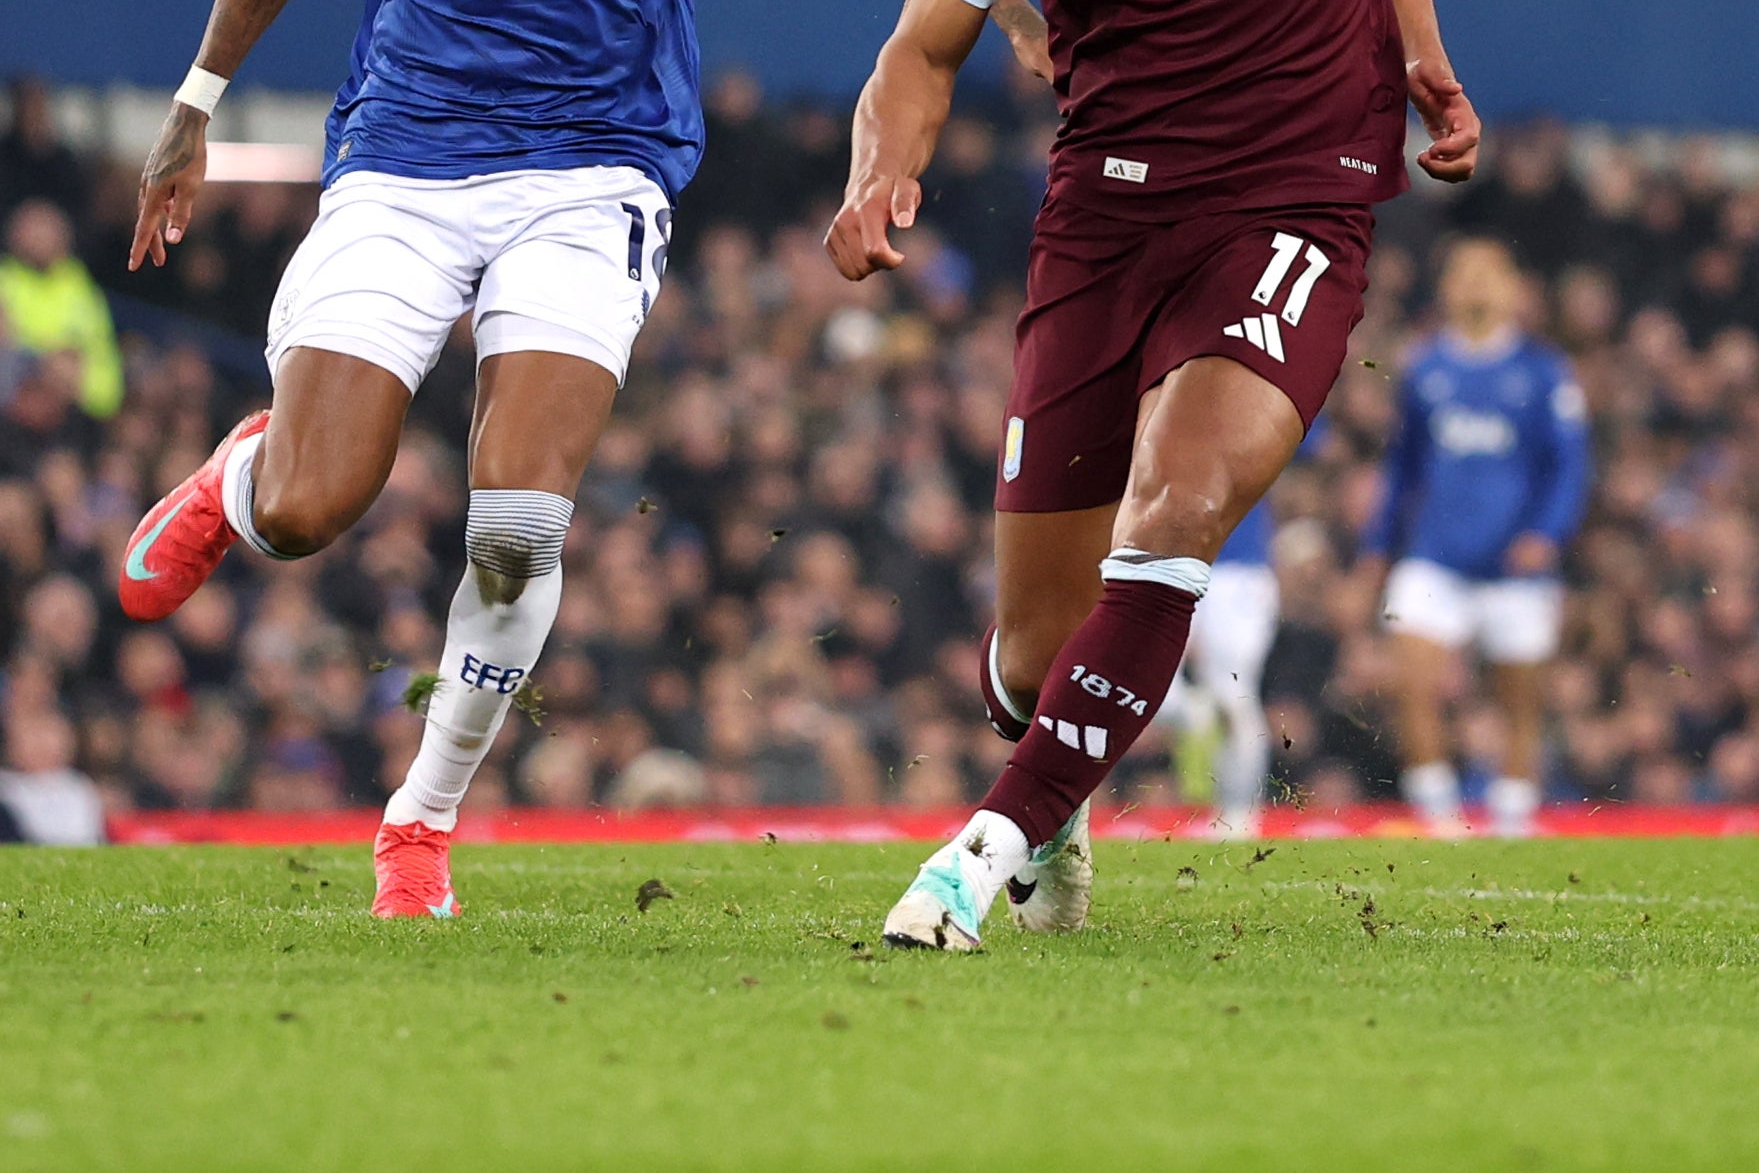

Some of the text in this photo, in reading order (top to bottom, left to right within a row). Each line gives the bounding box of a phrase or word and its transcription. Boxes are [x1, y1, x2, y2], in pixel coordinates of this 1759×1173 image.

[1250, 231, 1331, 327] 11
[461, 653, 524, 693] EFC
[1070, 665, 1148, 716] 1874
